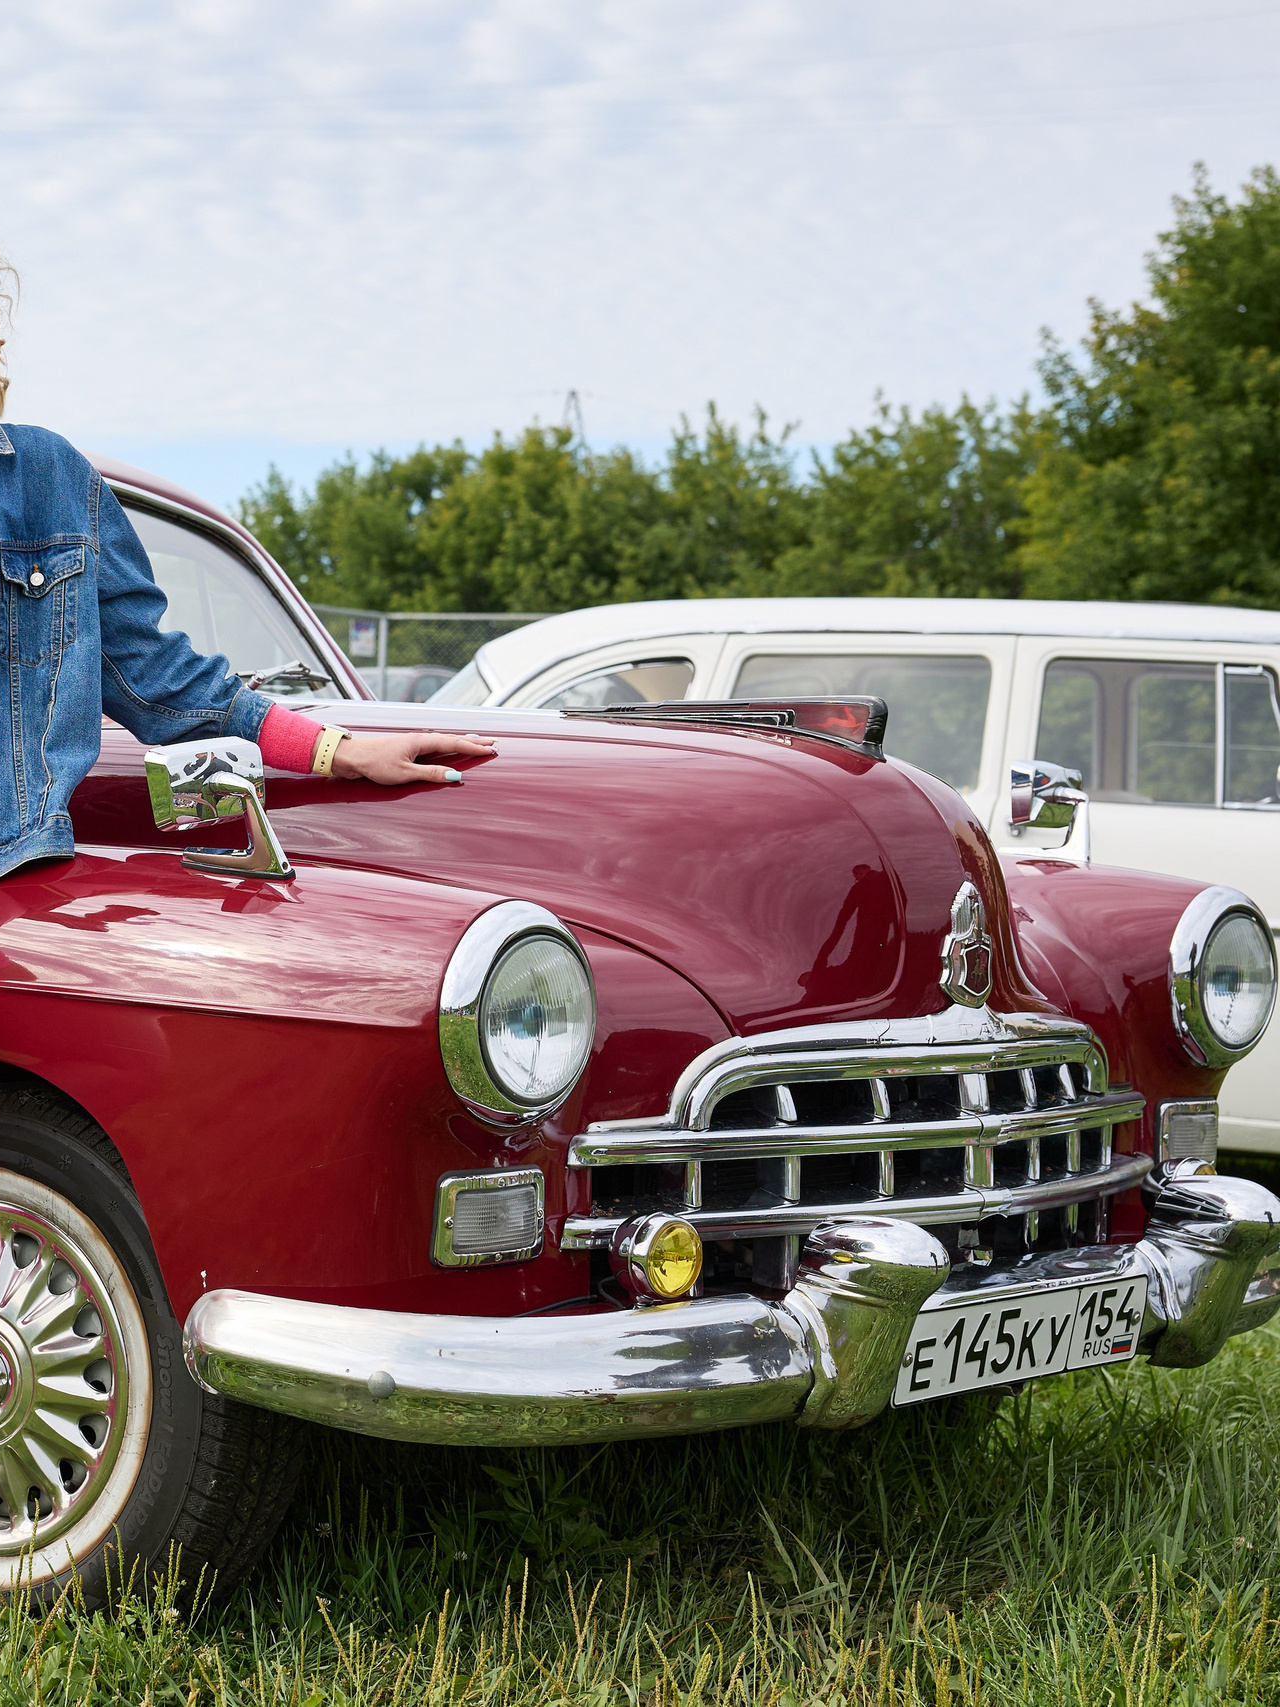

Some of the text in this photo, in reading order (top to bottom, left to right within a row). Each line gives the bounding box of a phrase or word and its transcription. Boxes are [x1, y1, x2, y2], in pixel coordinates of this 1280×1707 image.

[1080, 1286, 1135, 1341] 154
[1081, 1338, 1112, 1359] RUS
[123, 1416, 174, 1541] LEOPARD
